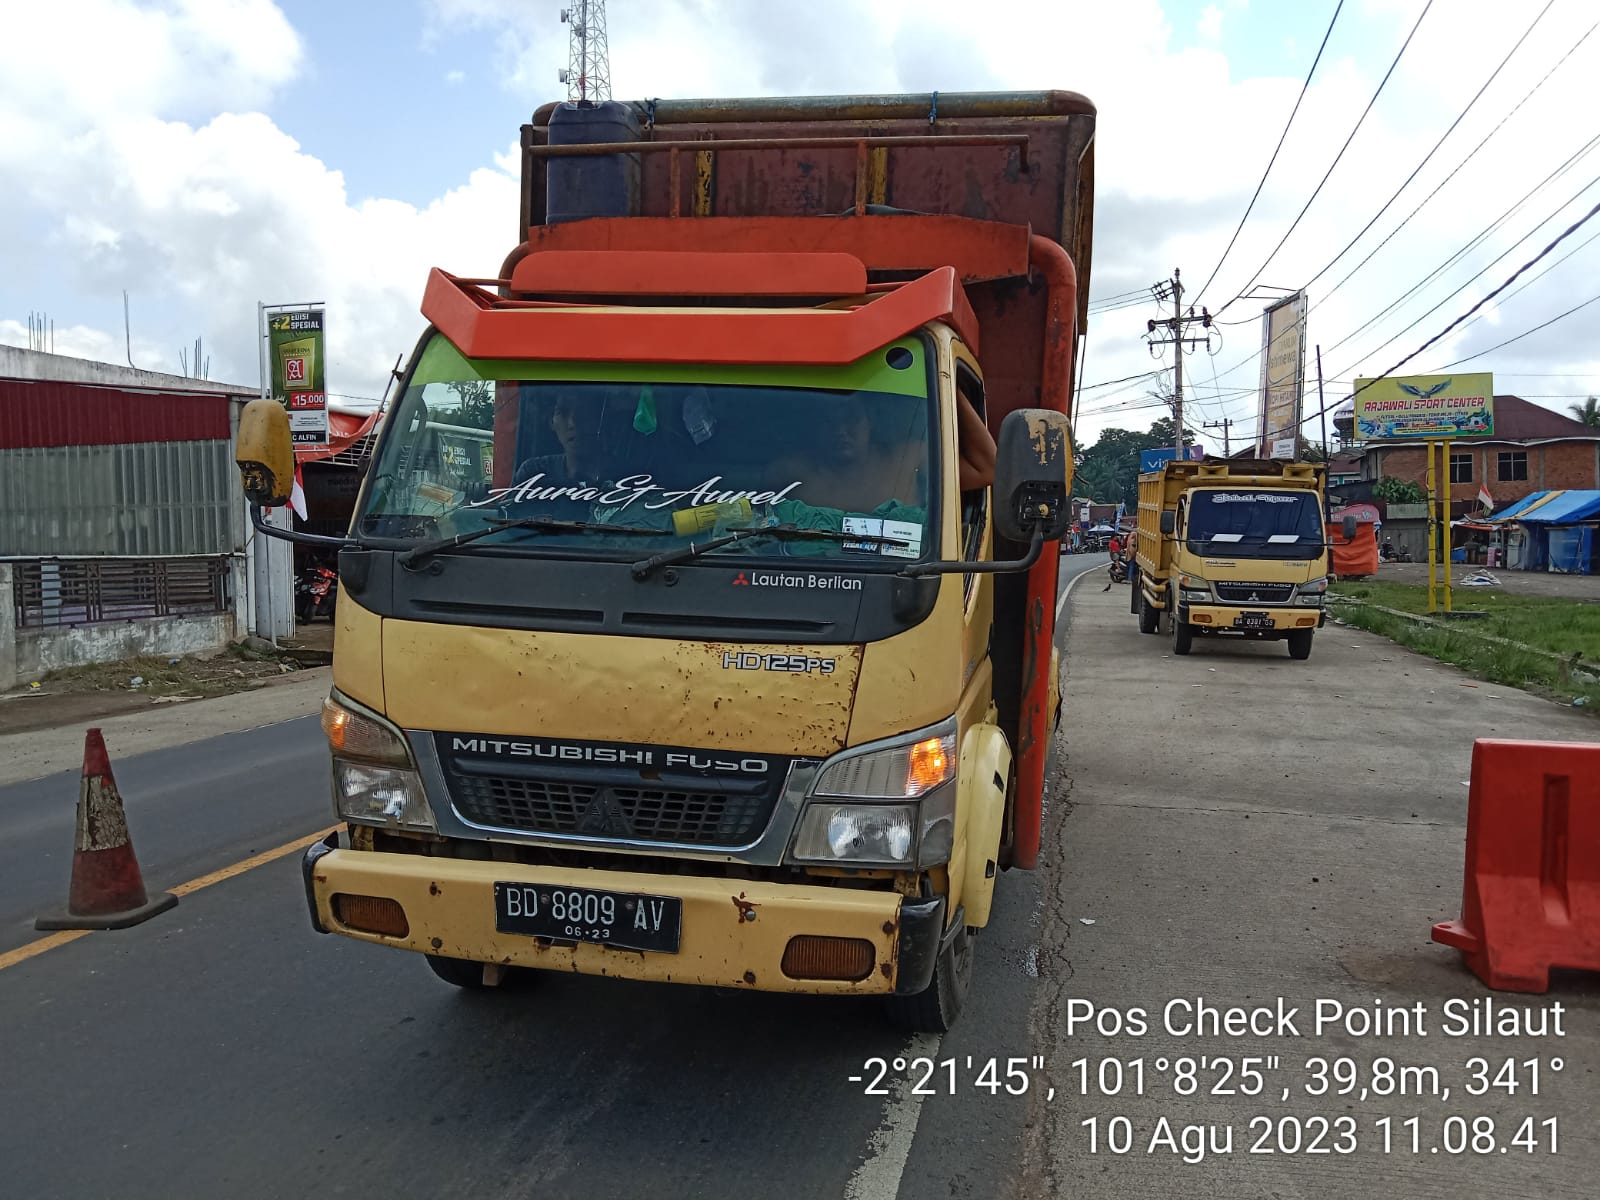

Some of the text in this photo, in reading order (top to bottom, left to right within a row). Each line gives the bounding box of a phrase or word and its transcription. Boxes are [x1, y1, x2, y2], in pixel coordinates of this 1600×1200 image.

[291, 321, 320, 330] SPESIAL
[1364, 397, 1485, 412] RAJAWALI SPORT CENTER
[298, 433, 317, 441] ALFIN
[1147, 458, 1165, 470] vi
[463, 473, 597, 510] Aura
[662, 475, 802, 508] Aurel
[751, 572, 862, 592] Lautan Berlian
[722, 652, 836, 674] HD125PS
[452, 736, 769, 774] MITSUBISHI FUSO
[505, 887, 665, 933] BD 8809 AV
